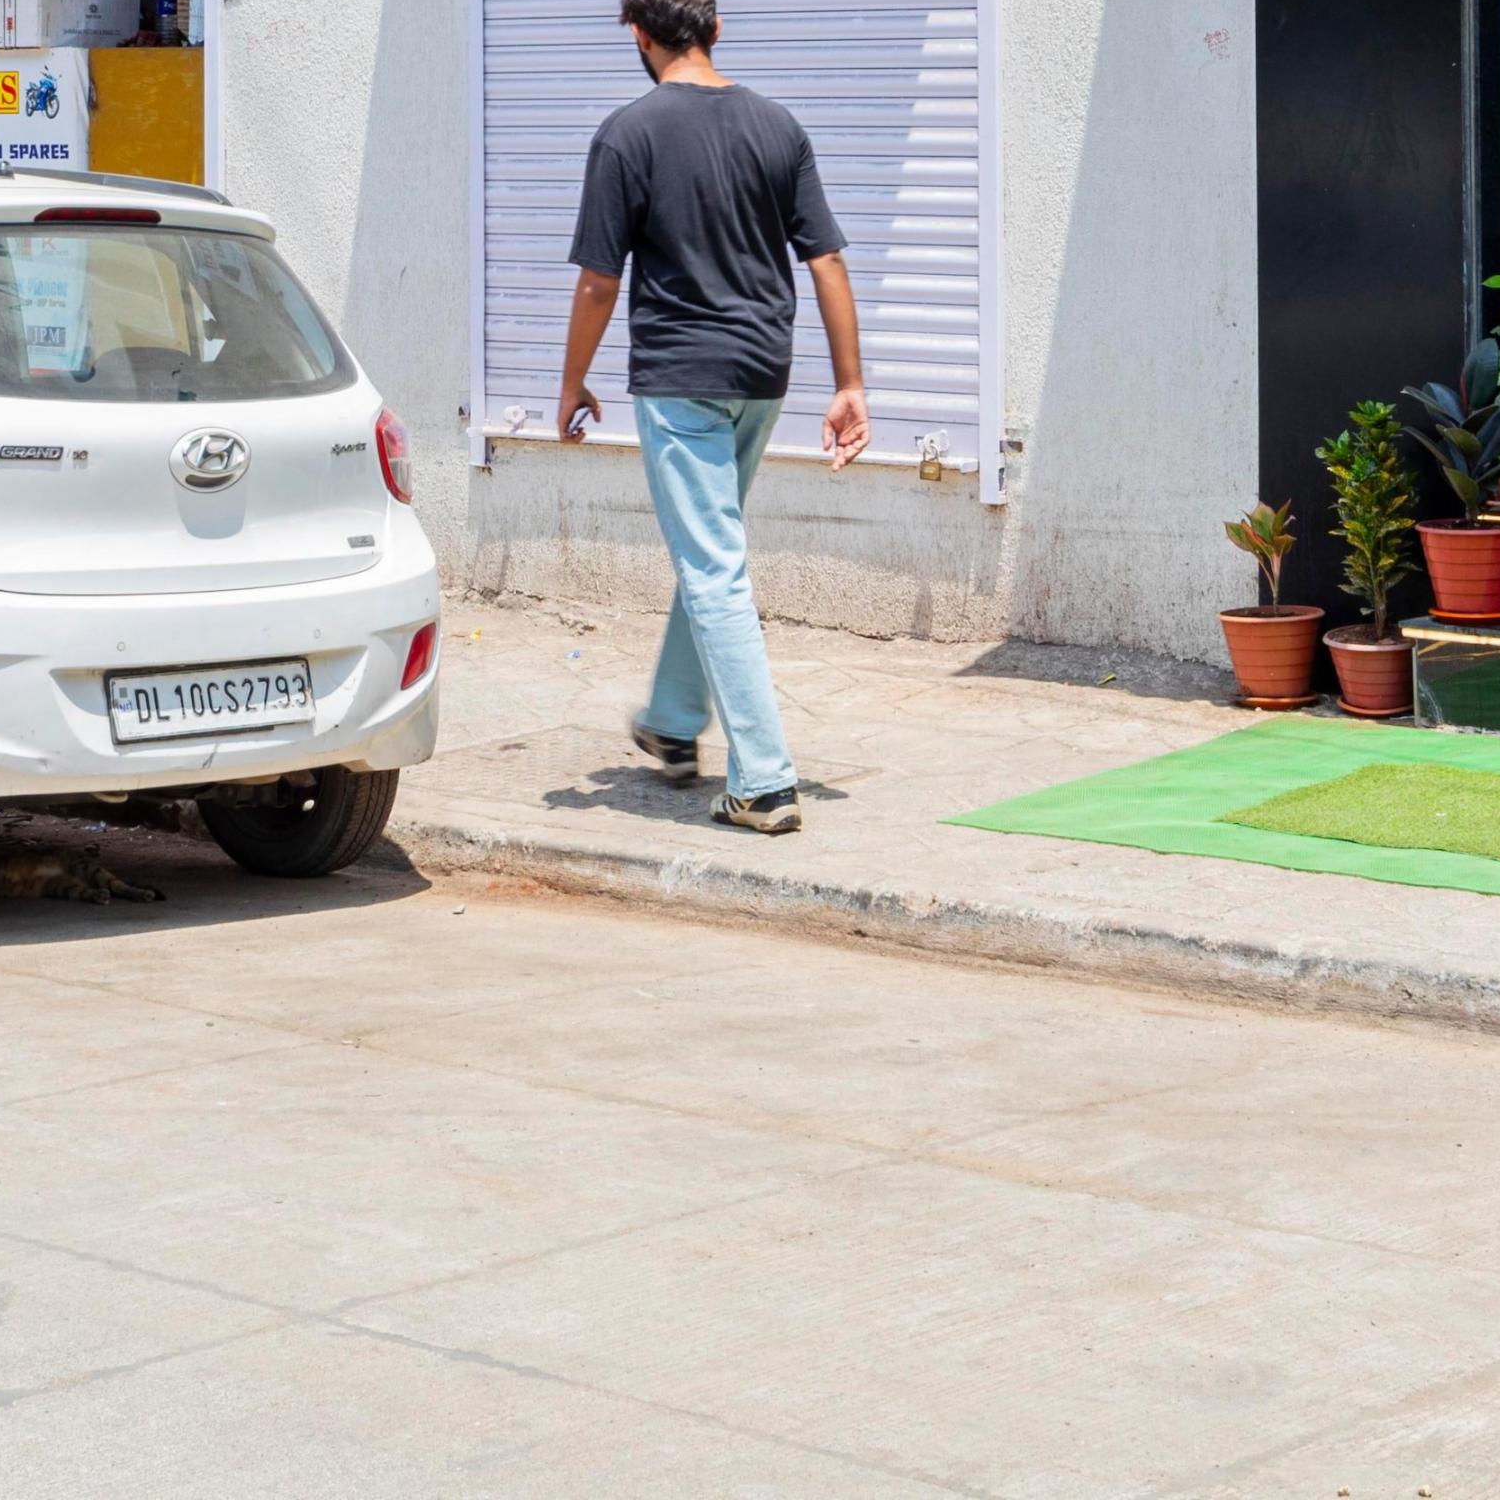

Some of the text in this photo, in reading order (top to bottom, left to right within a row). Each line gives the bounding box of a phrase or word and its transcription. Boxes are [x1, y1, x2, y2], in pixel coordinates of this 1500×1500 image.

[9, 143, 69, 160] SPARES
[0, 446, 62, 458] GRAND
[134, 673, 308, 723] DL10CS2793
